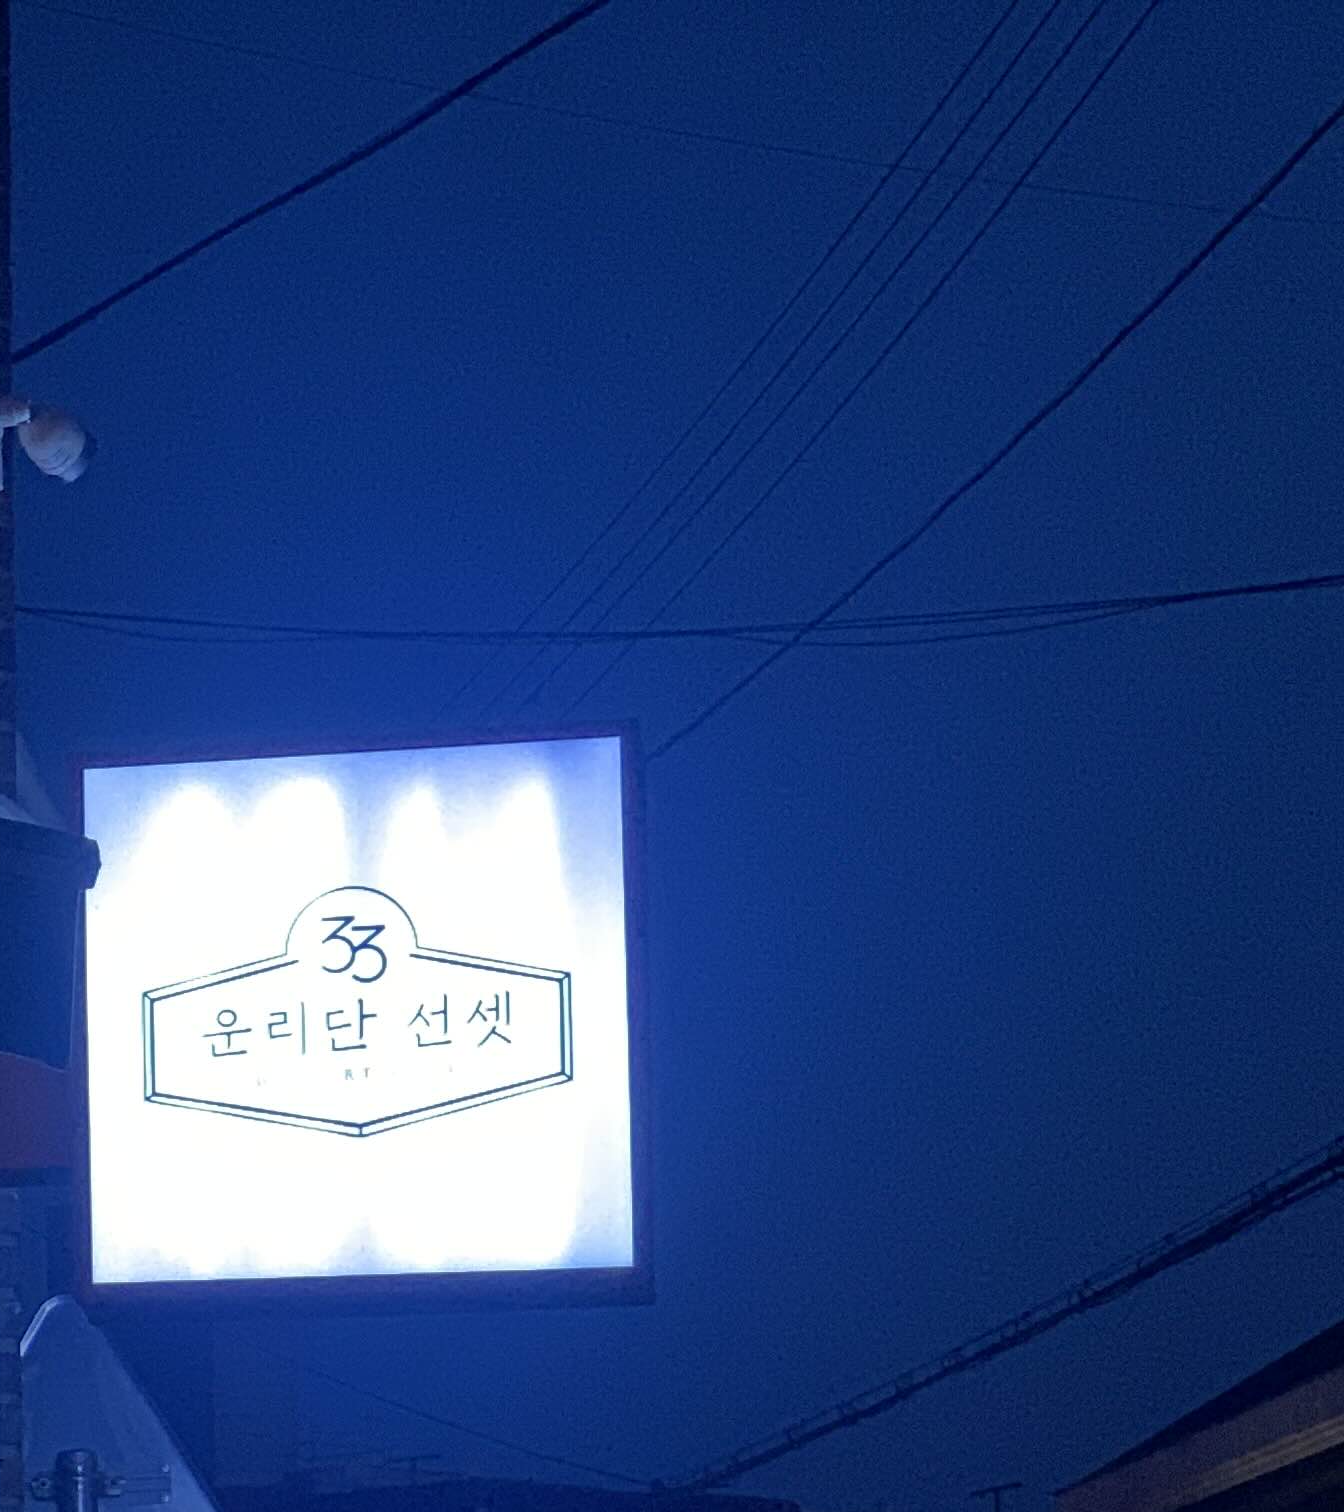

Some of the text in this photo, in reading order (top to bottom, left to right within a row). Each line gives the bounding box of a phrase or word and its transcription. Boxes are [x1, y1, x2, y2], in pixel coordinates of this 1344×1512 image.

[321, 915, 387, 983] 33
[202, 990, 513, 1058] 운리단 선셋
